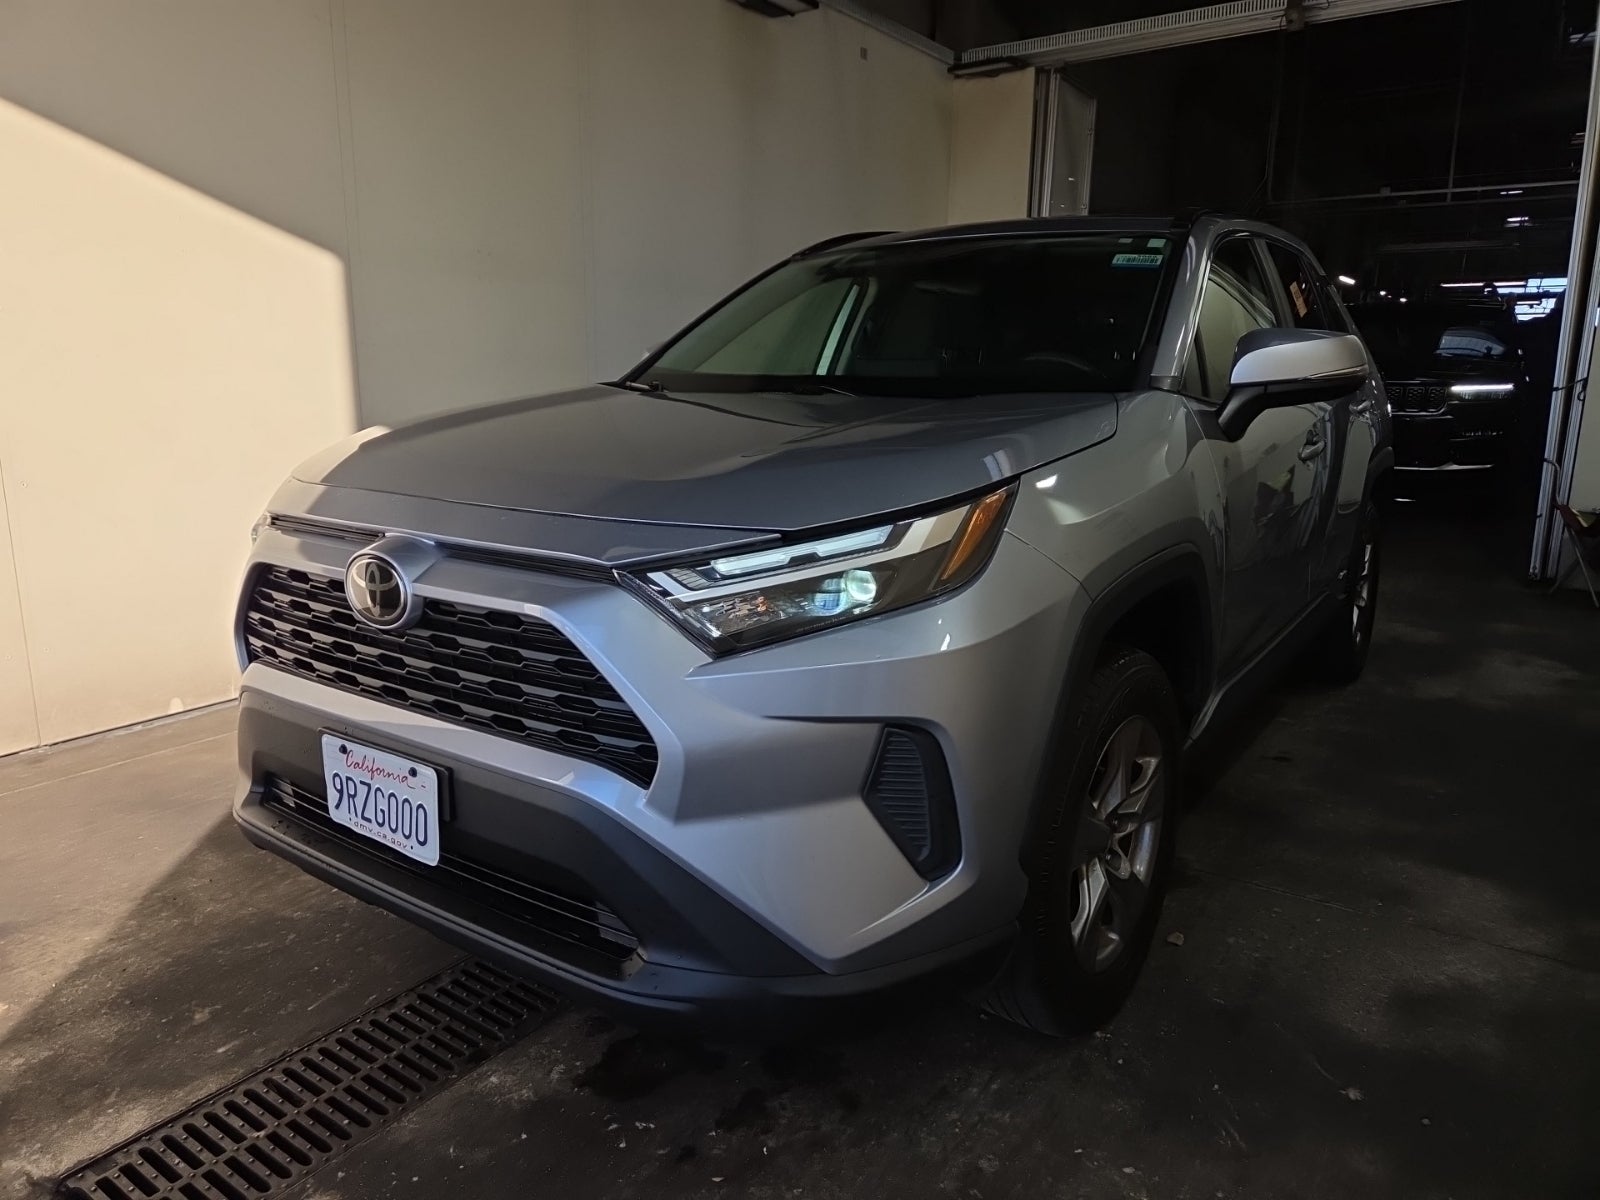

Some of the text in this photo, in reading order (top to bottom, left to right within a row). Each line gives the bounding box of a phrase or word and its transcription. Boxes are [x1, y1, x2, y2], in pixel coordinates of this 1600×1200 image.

[345, 749, 416, 789] California
[332, 772, 428, 847] 9RZG000
[353, 821, 408, 849] dmv.ca.gov
